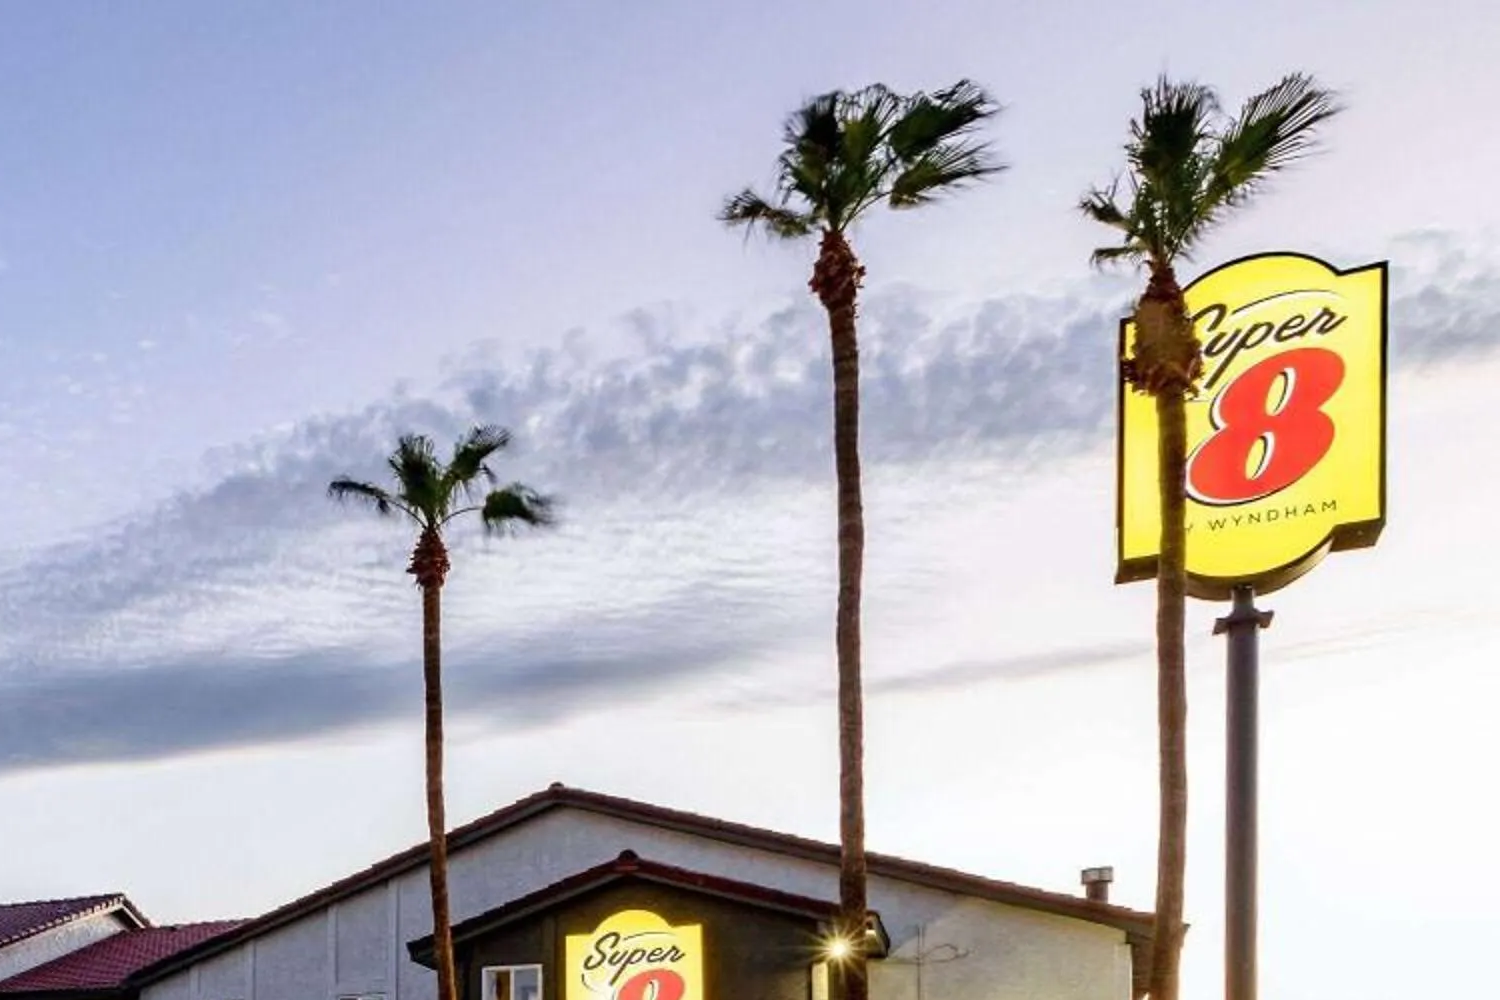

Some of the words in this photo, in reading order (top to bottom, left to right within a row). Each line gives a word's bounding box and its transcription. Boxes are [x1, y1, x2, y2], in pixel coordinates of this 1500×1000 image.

[1189, 347, 1346, 503] 8
[1208, 499, 1338, 532] WYNDHAM
[583, 932, 686, 986] Super
